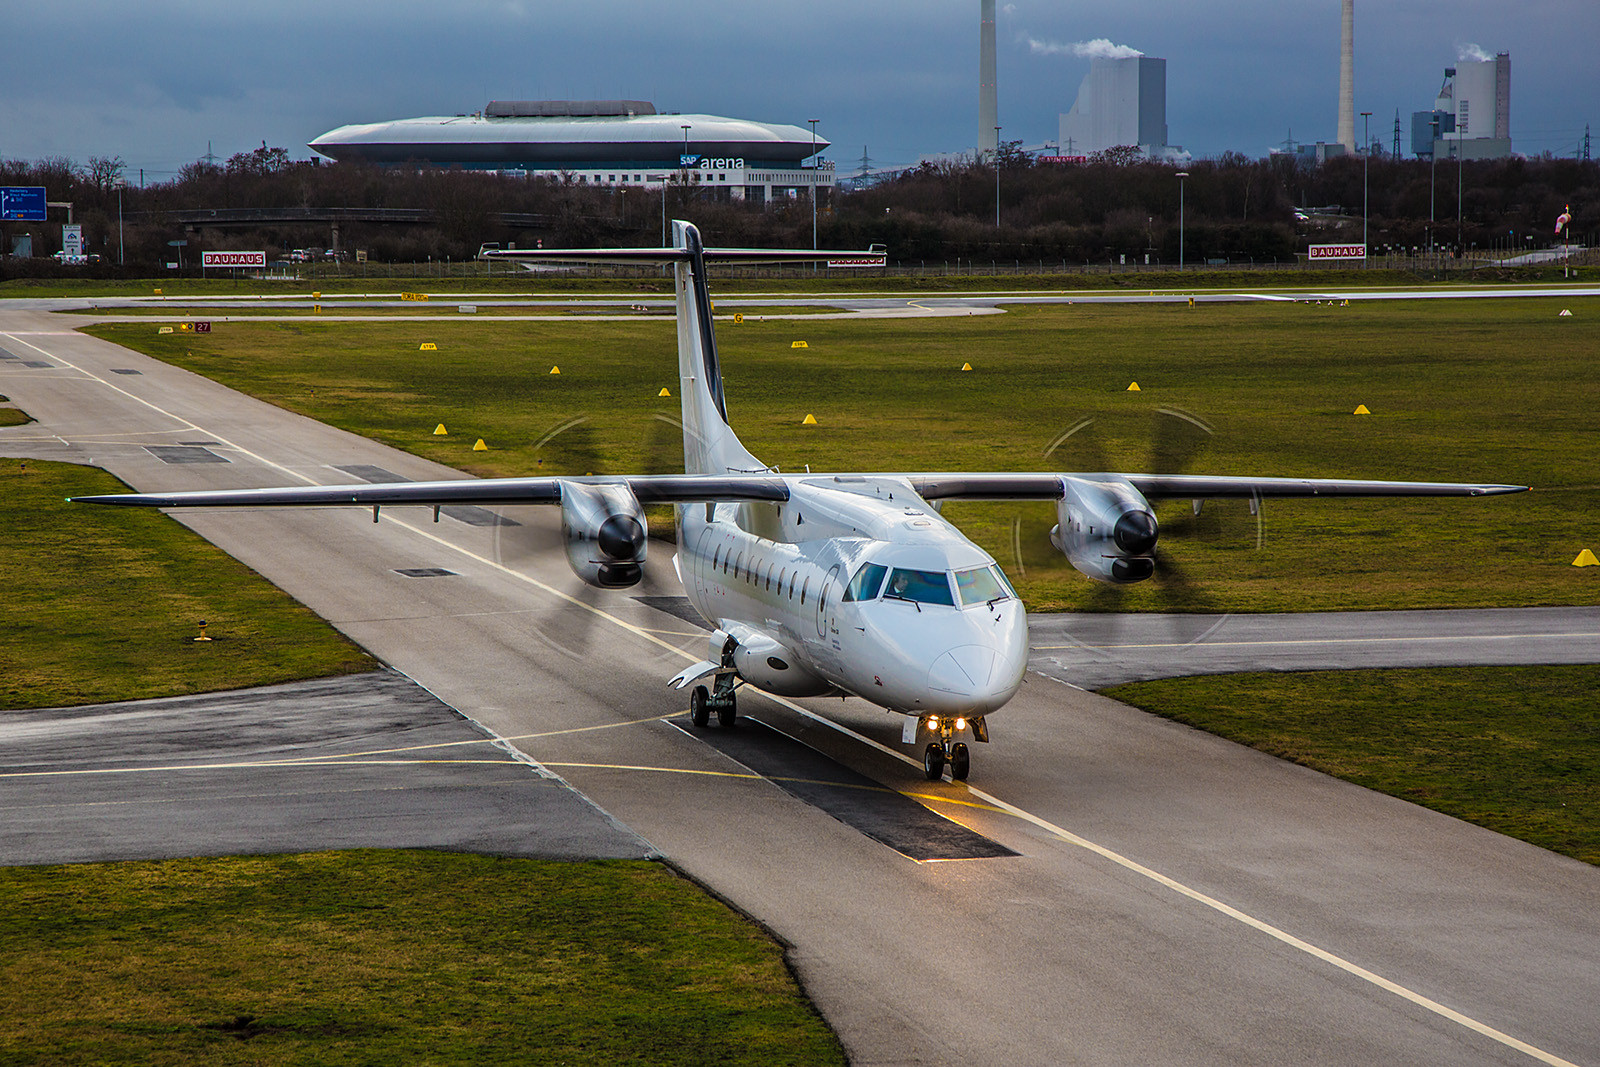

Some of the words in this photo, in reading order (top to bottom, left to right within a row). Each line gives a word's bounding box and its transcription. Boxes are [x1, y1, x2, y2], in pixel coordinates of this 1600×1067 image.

[680, 156, 697, 165] SAP
[700, 157, 744, 169] arena
[1311, 247, 1364, 257] BAUHAUS
[205, 255, 263, 263] BAUHAUS
[735, 314, 742, 323] G
[197, 323, 208, 331] 27
